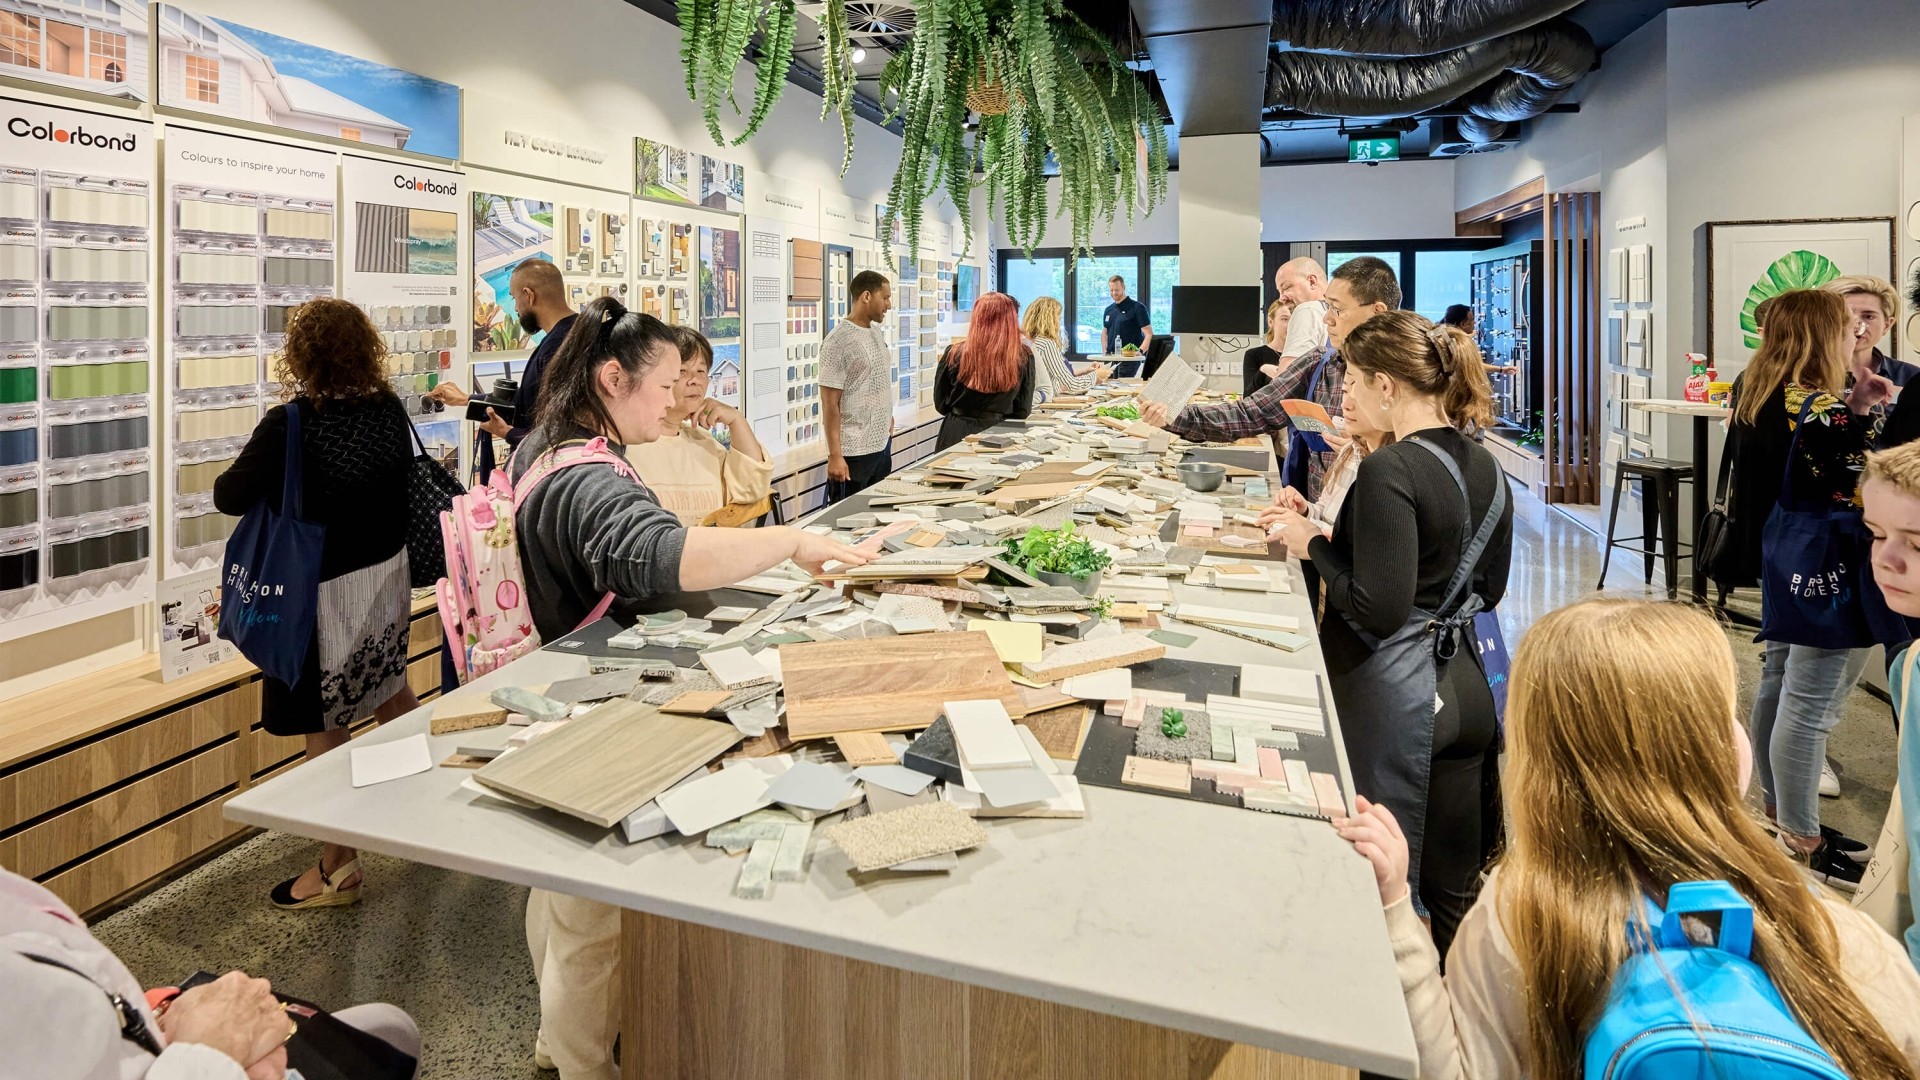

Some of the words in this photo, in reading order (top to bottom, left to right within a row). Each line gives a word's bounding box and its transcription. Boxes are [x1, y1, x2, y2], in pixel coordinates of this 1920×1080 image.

[7, 117, 136, 152] Colorbond
[181, 150, 223, 165] Colours
[226, 158, 238, 167] to
[240, 160, 273, 172] inspire
[276, 165, 297, 175] your
[299, 168, 325, 179] home
[393, 174, 457, 196] Colorbond
[1688, 380, 1705, 389] AJAX
